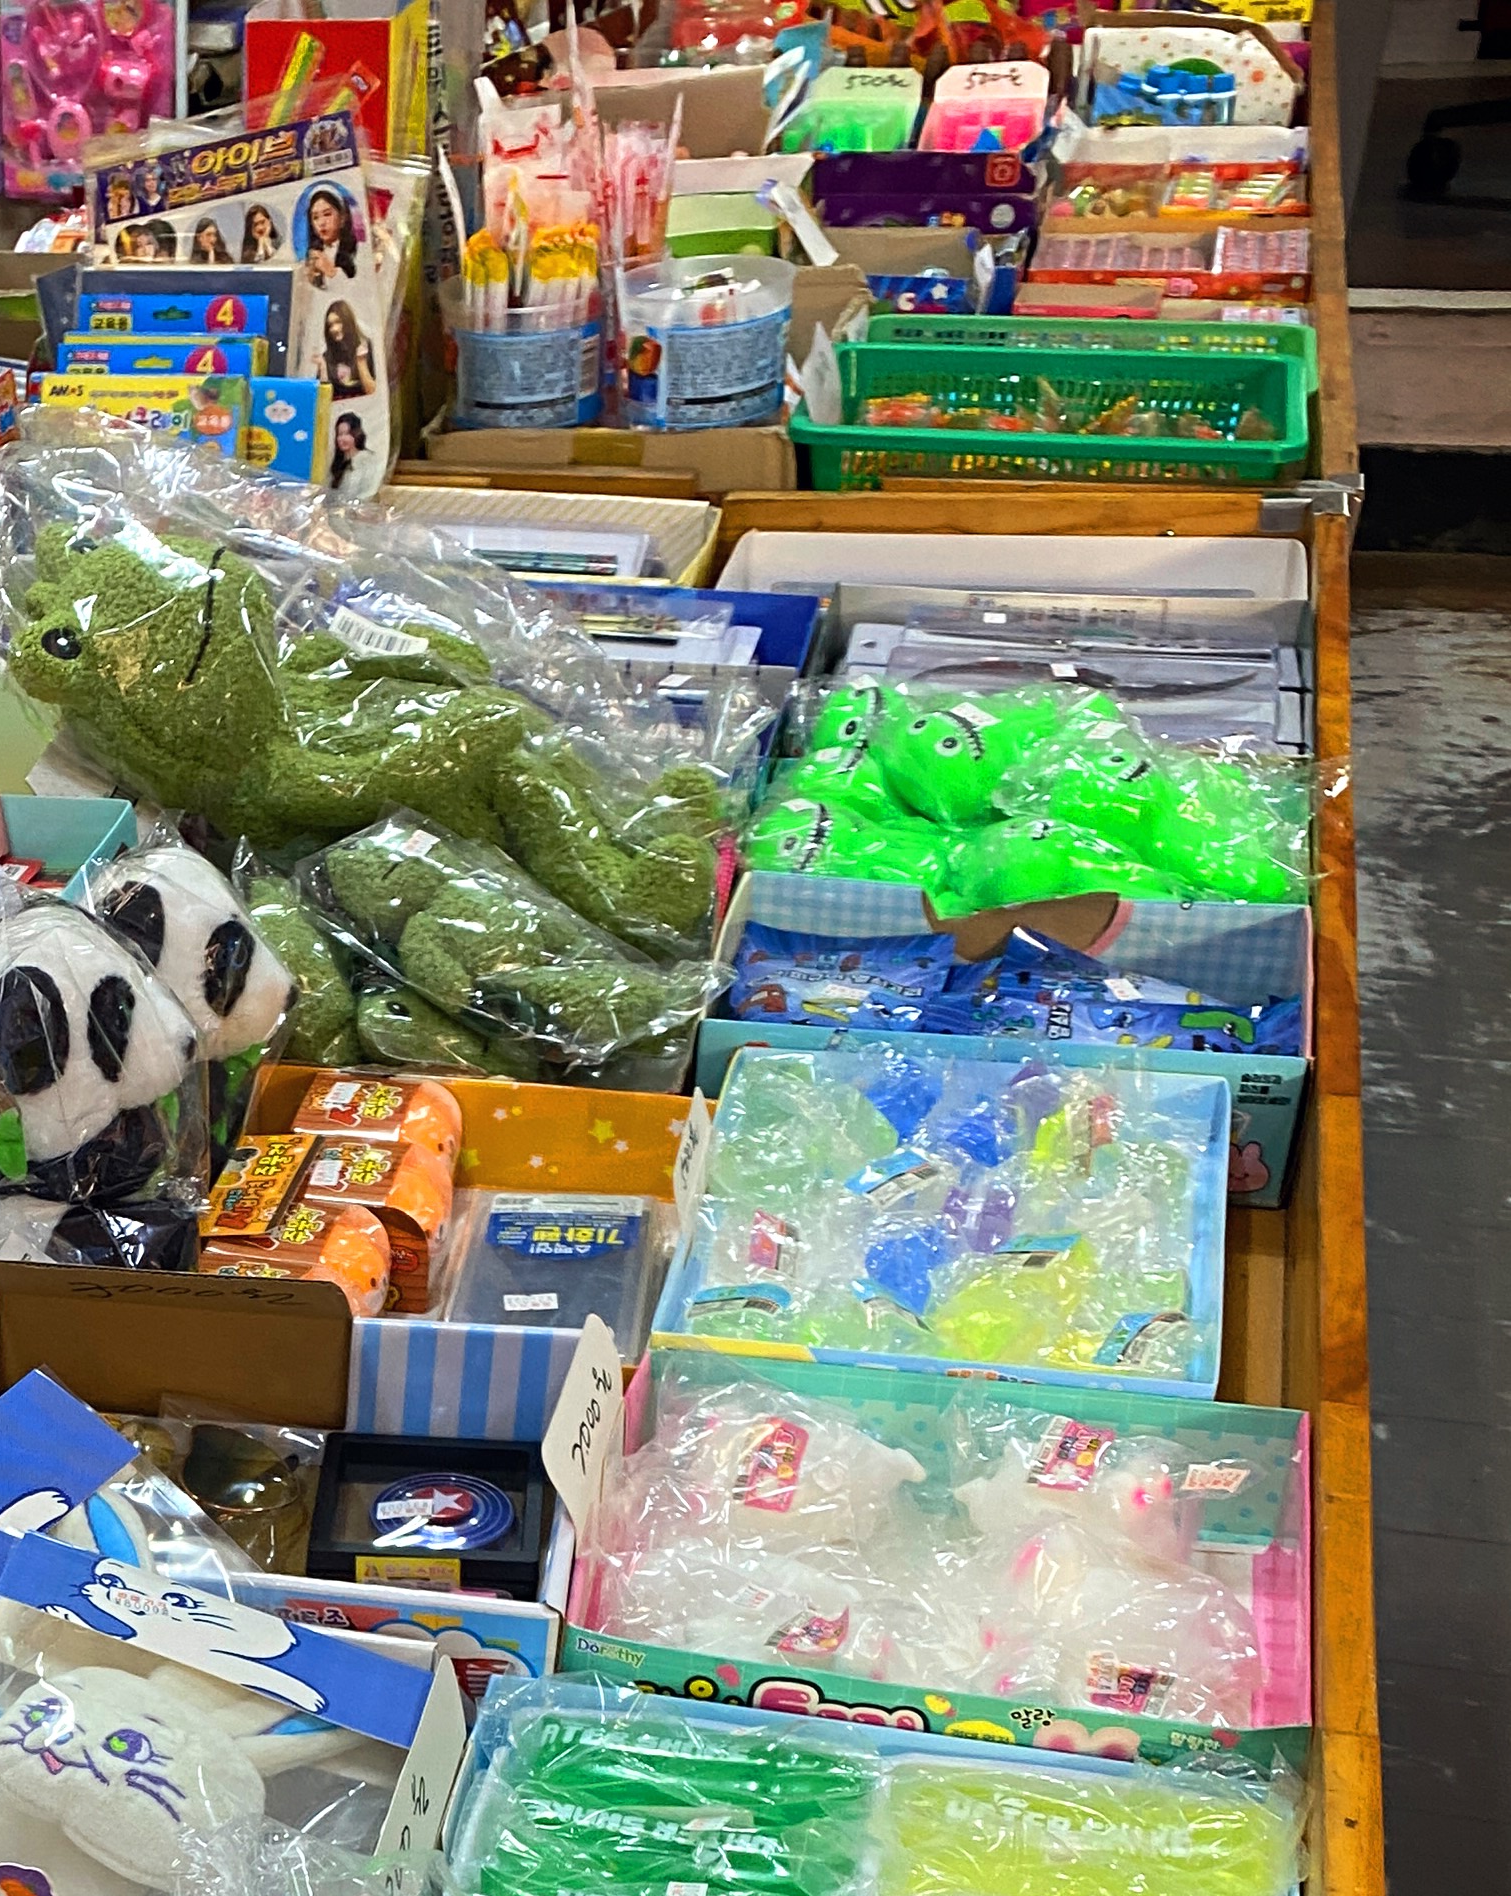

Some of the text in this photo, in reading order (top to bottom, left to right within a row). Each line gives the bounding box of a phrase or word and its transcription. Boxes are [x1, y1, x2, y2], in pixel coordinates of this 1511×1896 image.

[191, 130, 298, 175] 아이브
[216, 298, 234, 327] 4
[195, 349, 215, 374] 4
[532, 1226, 625, 1245] 기화펜
[117, 1591, 168, 1608] 판매가격
[576, 1638, 647, 1669] Dorothy
[1011, 1707, 1056, 1730] 말랑
